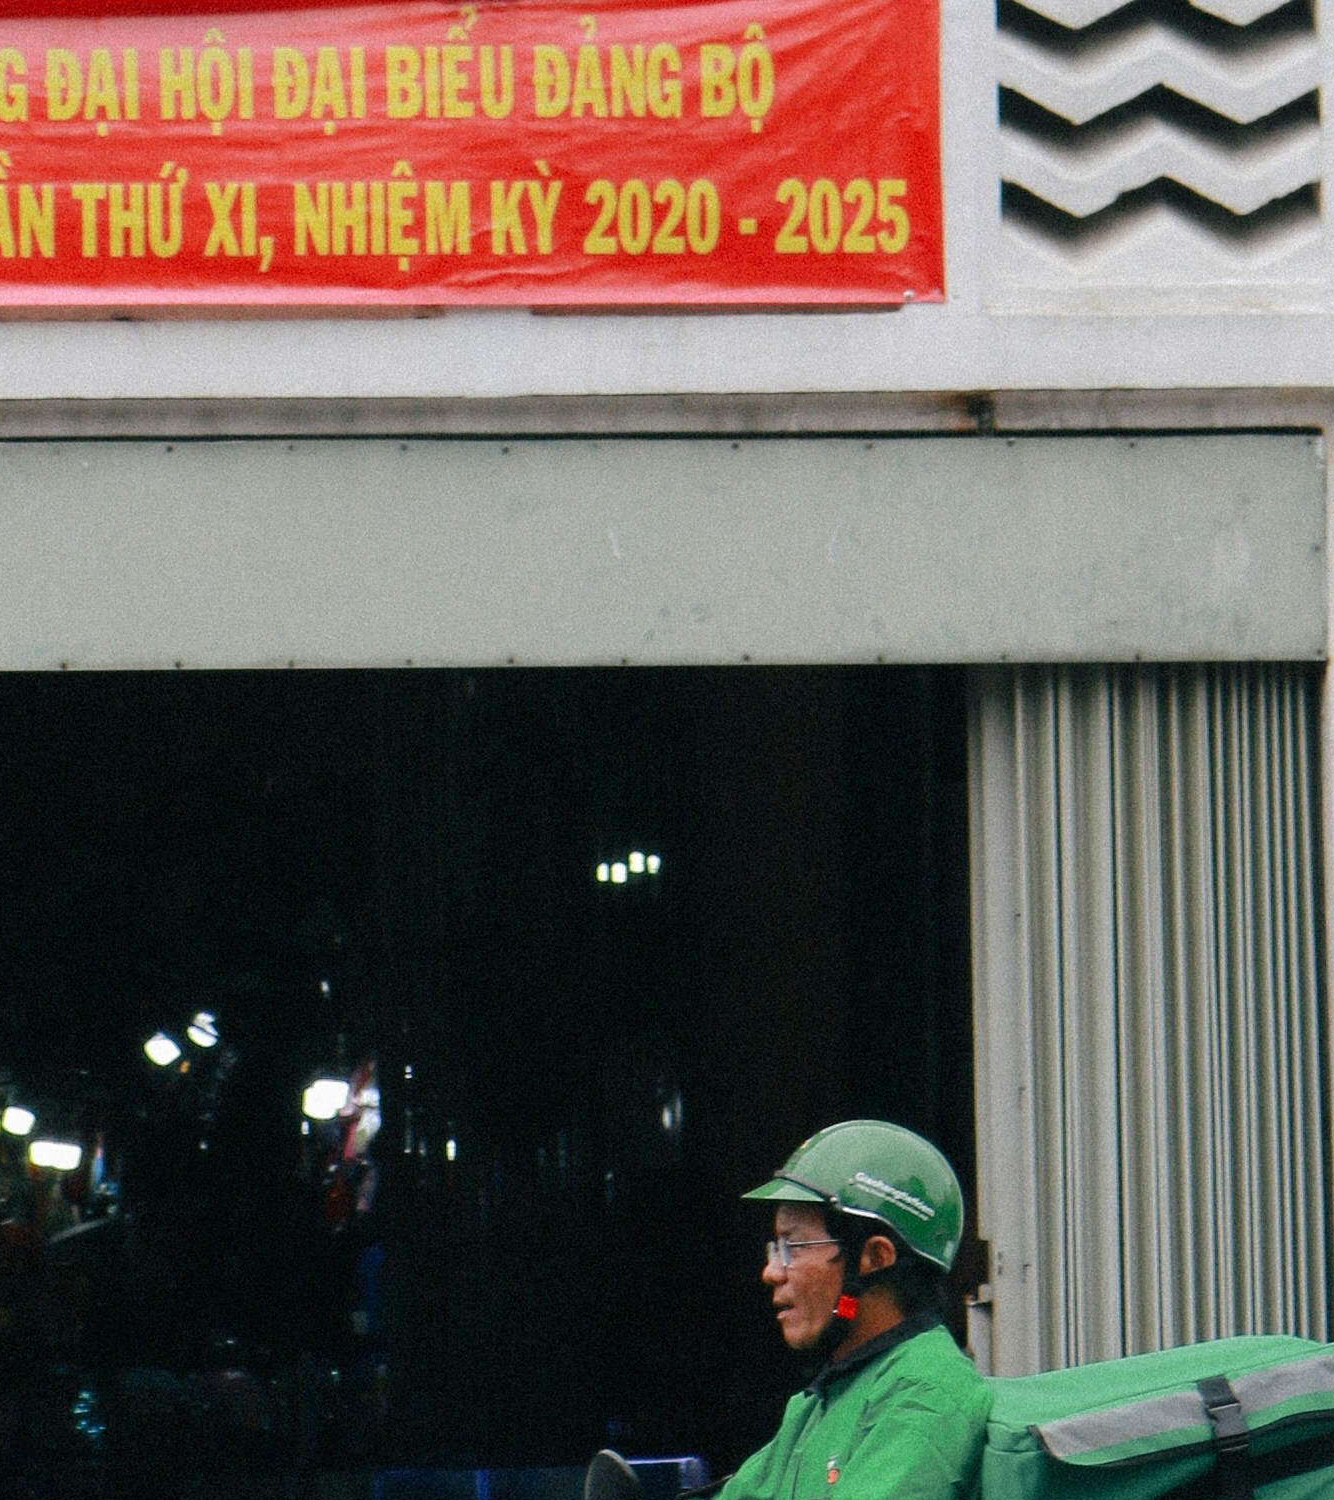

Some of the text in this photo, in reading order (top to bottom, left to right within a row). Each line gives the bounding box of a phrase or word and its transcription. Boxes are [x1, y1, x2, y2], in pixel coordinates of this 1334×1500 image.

[44, 46, 141, 137] ĐẠI
[158, 27, 255, 137] HỘI
[271, 45, 367, 136] ĐẠI
[385, 4, 515, 121] BIỂU
[531, 13, 684, 121] ĐẢNG
[699, 21, 776, 134] BỘ
[70, 159, 190, 260] THỨ
[203, 180, 276, 273] XI,
[292, 159, 473, 273] NHIỆM
[489, 157, 564, 257] KỲ
[582, 177, 722, 257] 2020
[774, 176, 912, 256] 2025
